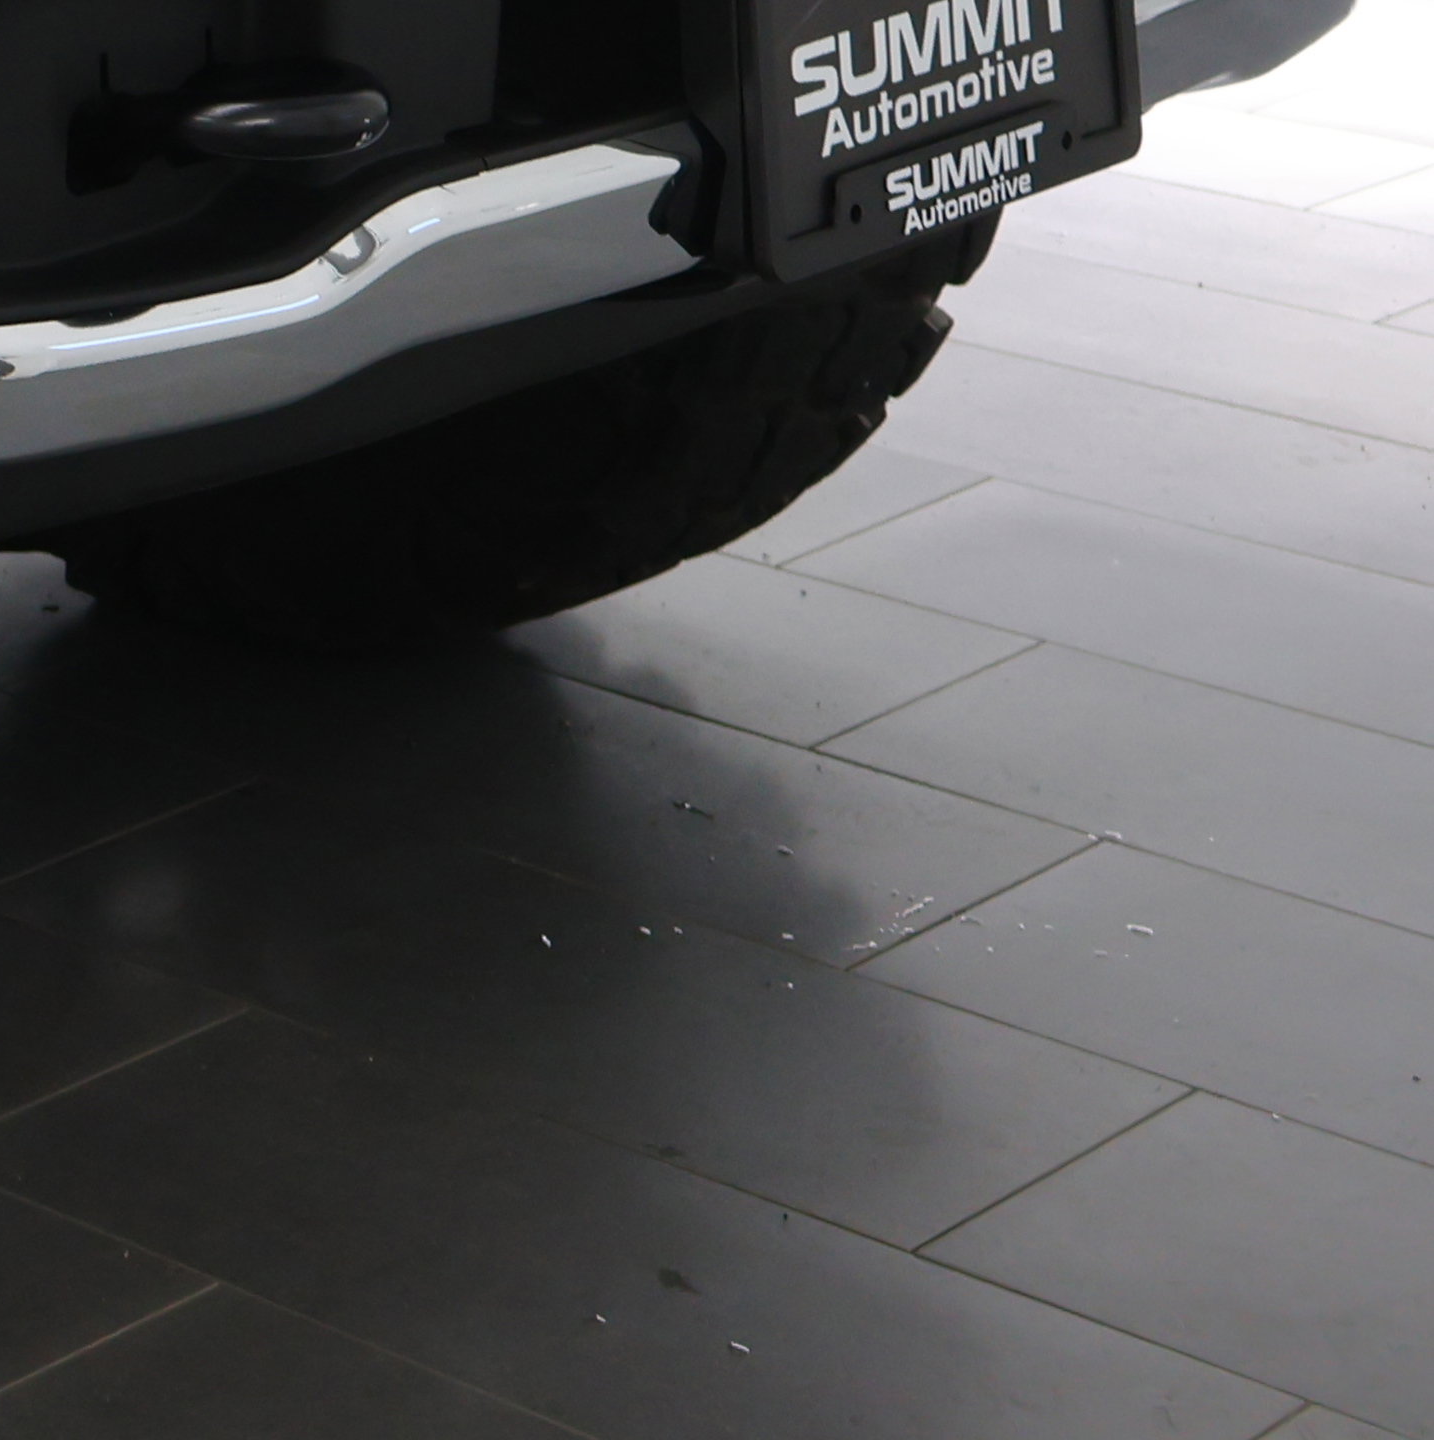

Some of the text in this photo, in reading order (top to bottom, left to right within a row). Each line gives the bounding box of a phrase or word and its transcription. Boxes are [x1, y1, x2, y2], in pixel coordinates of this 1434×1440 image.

[820, 47, 1056, 158] Automotive
[885, 121, 1044, 212] SUMMIT
[903, 171, 1033, 236] Automotive
